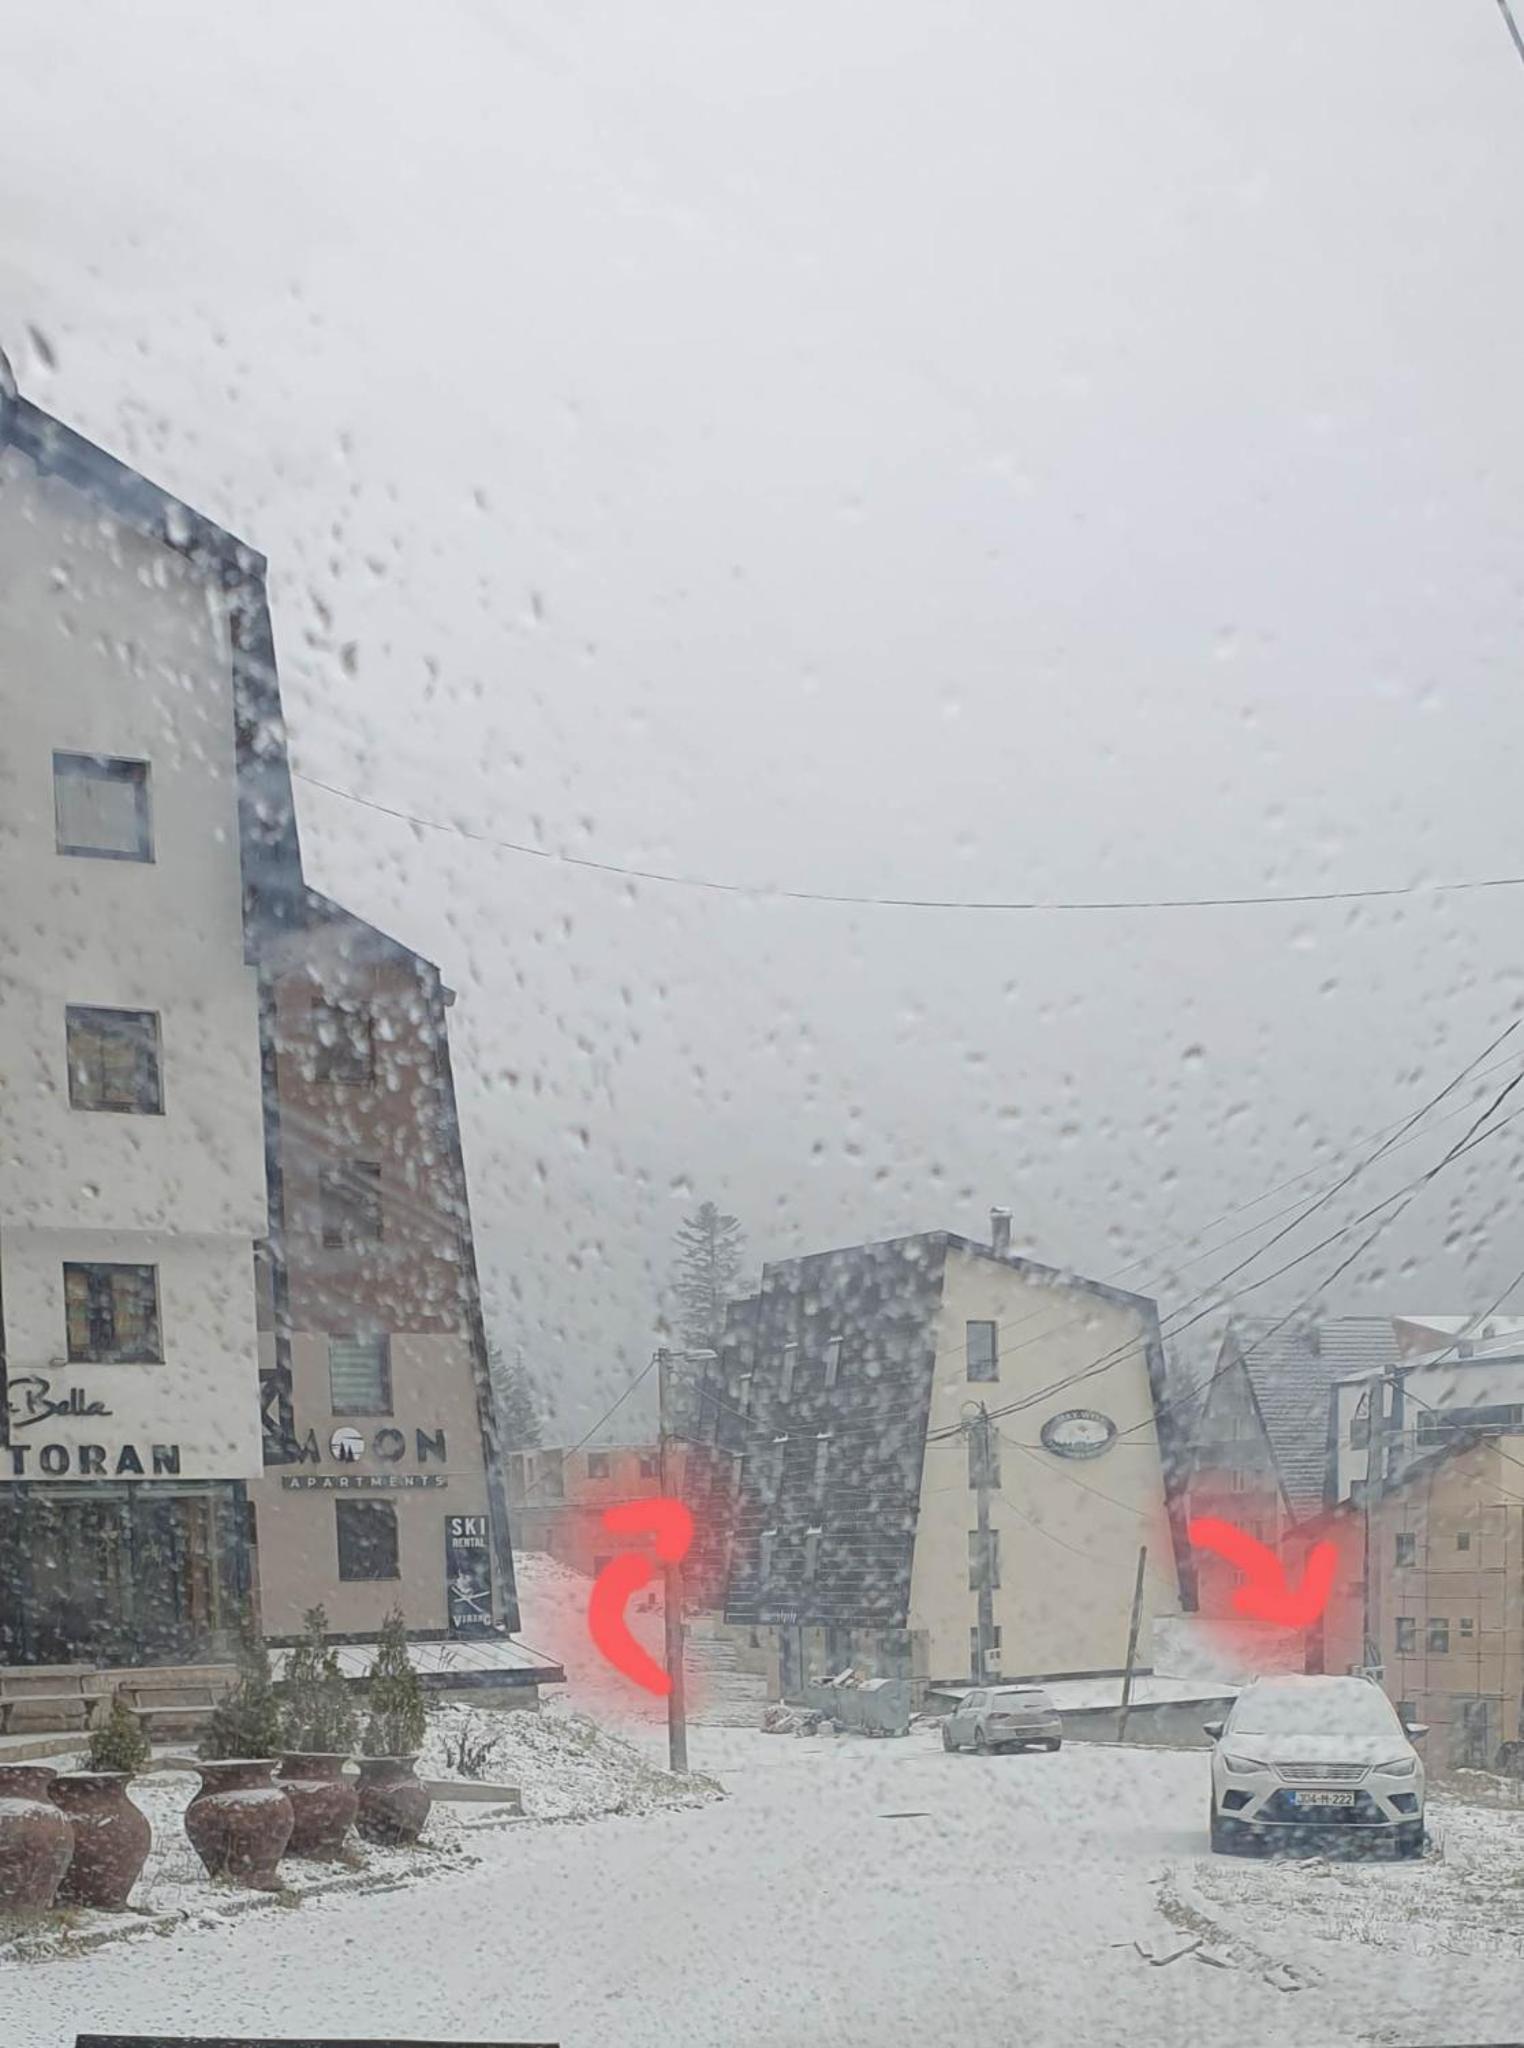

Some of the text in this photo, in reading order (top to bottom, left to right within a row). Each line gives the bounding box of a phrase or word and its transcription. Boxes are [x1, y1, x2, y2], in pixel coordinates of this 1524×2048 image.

[9, 1376, 113, 1427] Bella
[6, 1444, 180, 1475] TORAN
[289, 1476, 445, 1489] APARTMENTS
[452, 1518, 486, 1536] SKI
[452, 1537, 486, 1548] RENTAL
